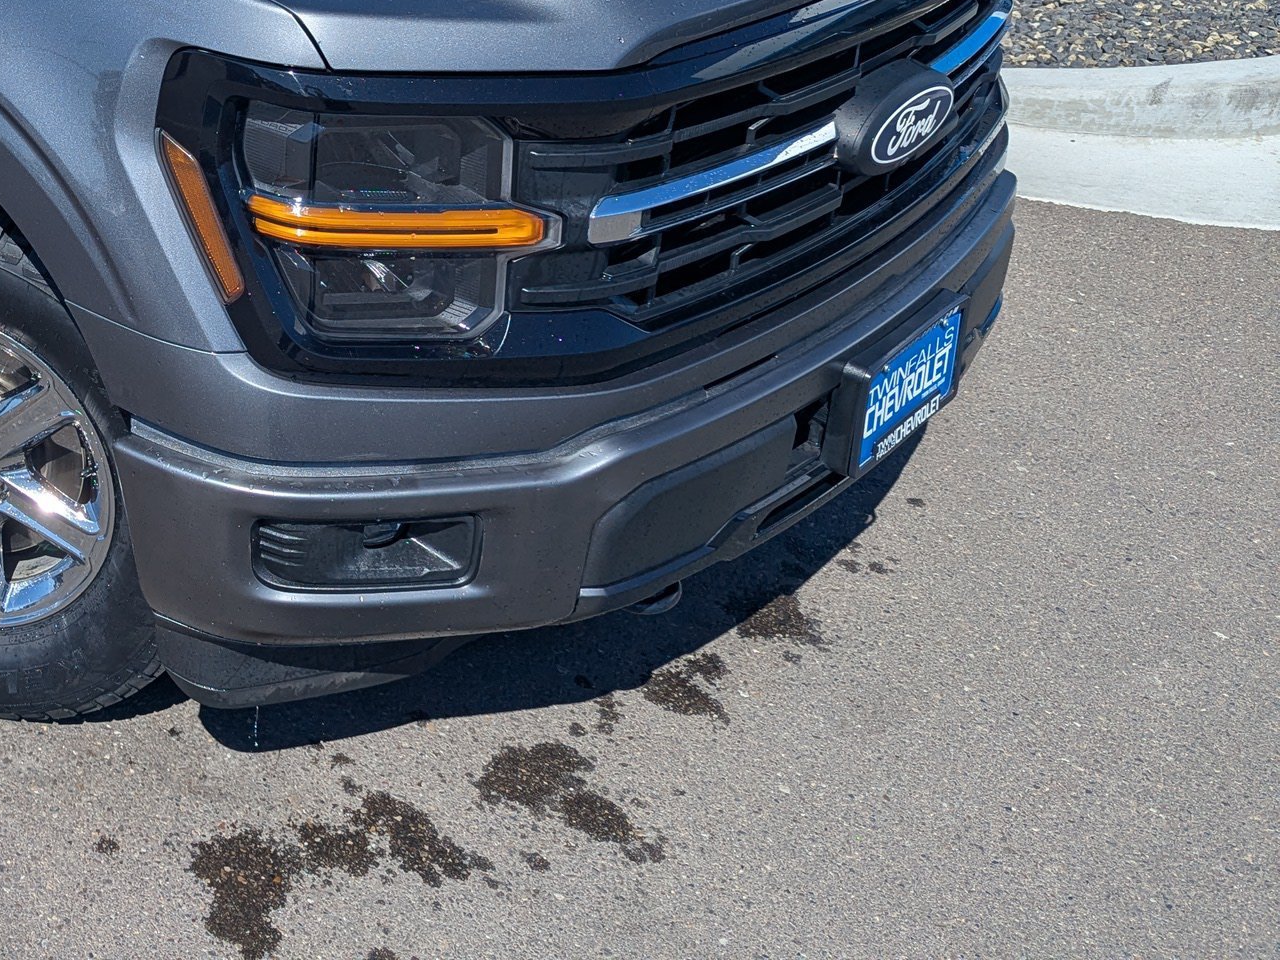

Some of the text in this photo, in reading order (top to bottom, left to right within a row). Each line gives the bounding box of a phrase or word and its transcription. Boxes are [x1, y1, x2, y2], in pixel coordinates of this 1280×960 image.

[887, 98, 942, 156] Ford
[863, 343, 953, 439] CHEVROLET
[895, 393, 941, 444] CHEVROLET
